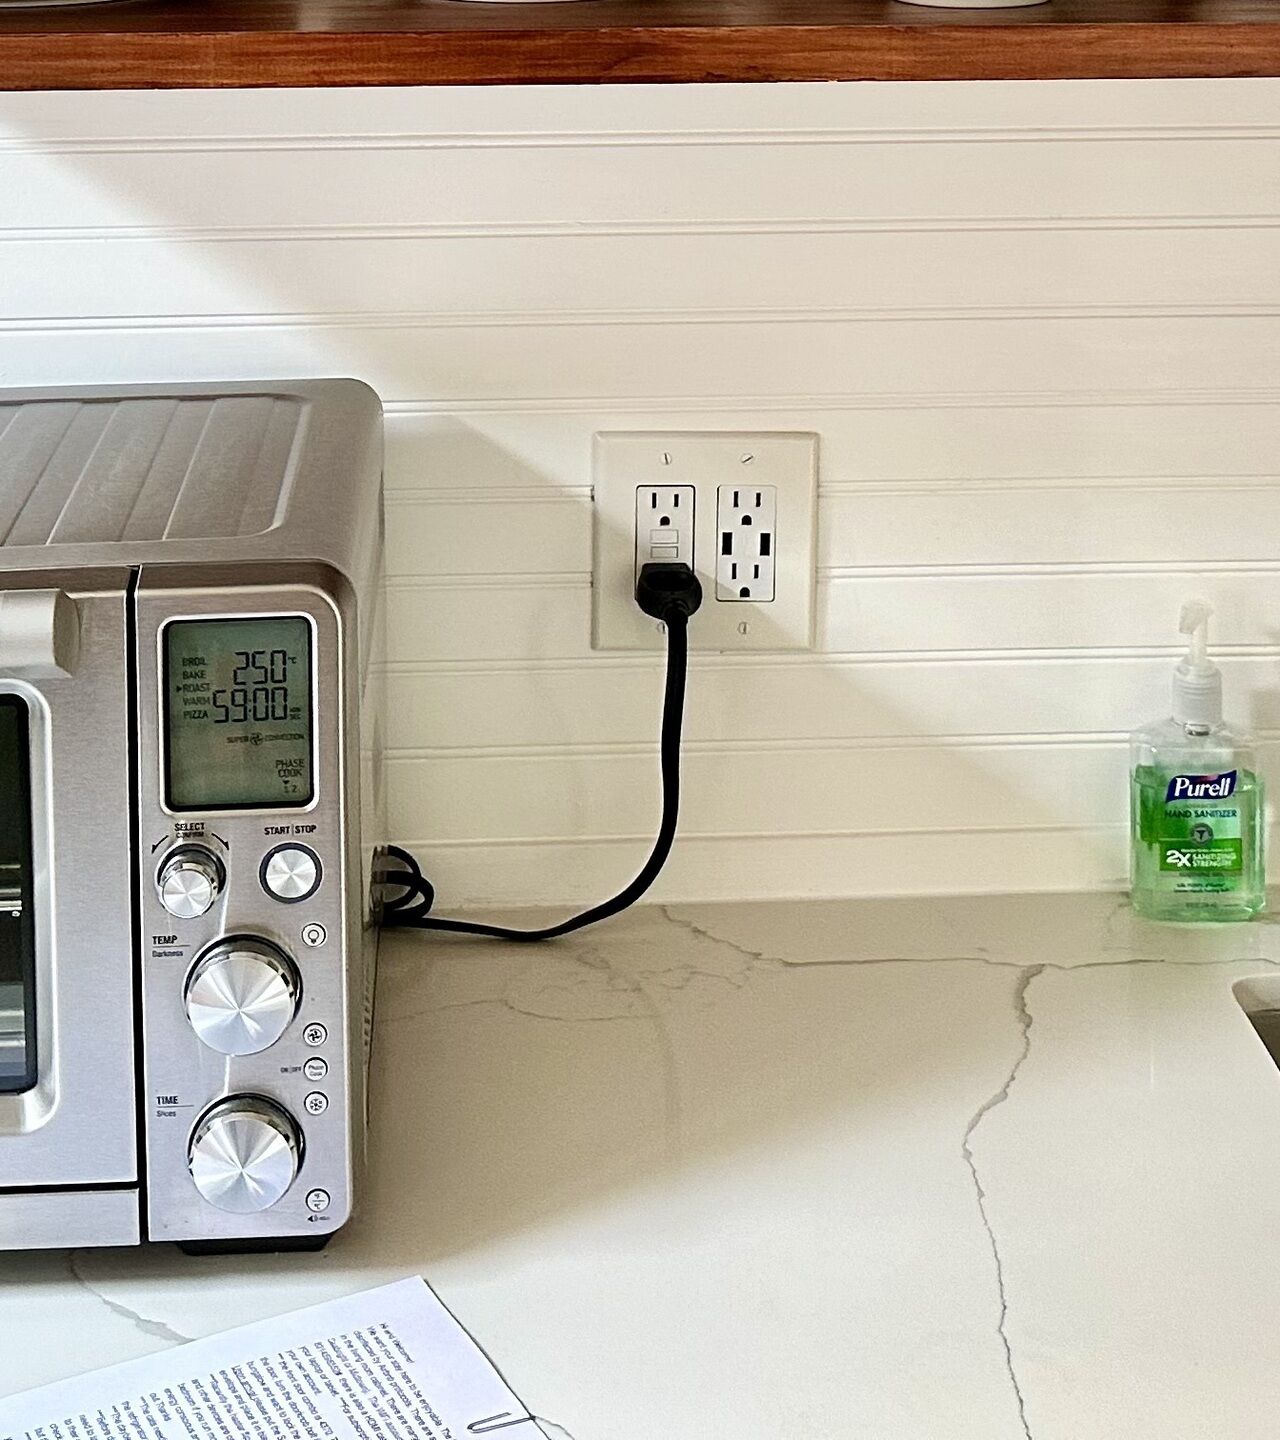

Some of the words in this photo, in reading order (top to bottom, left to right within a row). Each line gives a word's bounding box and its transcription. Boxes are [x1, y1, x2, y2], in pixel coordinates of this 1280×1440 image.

[182, 656, 207, 667] BROIL
[233, 650, 287, 686] 250
[182, 670, 207, 680] BAKE
[183, 682, 210, 693] ROAST
[212, 686, 288, 723] 59:00
[183, 710, 209, 720] PIZZA
[275, 759, 305, 769] PHASE
[278, 768, 303, 778] COOK
[1174, 777, 1232, 797] Purell
[1164, 809, 1192, 818] HAND
[1194, 809, 1237, 818] SANITIZER
[174, 822, 205, 832] SELECT
[152, 935, 178, 945] TEMP
[156, 1095, 179, 1105] TIME
[284, 1349, 299, 1361] your
[297, 1345, 312, 1358] your
[343, 1339, 355, 1348] the
[384, 1397, 403, 1414] There
[396, 1414, 408, 1425] are
[280, 1391, 293, 1401] the
